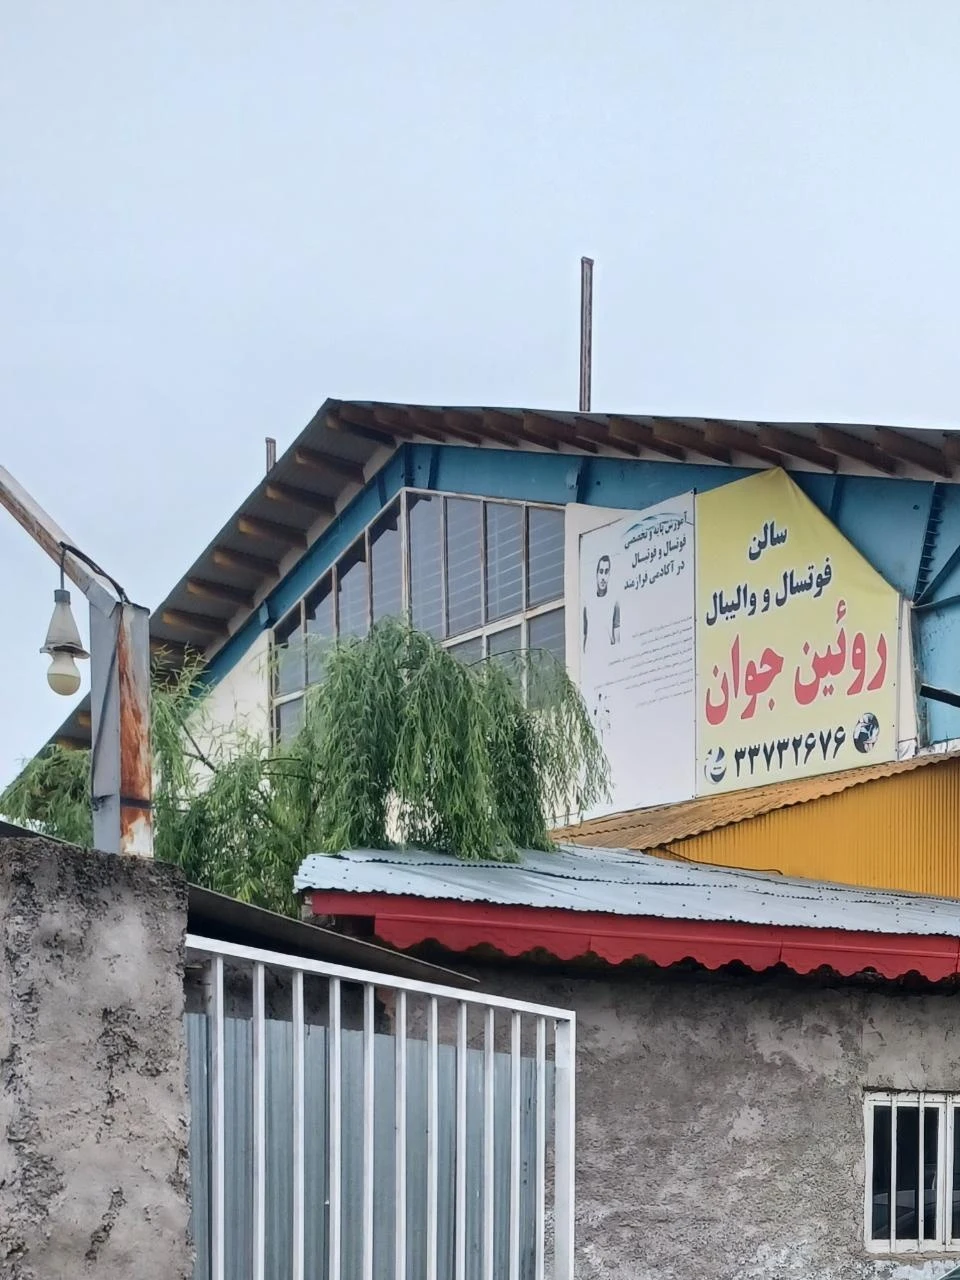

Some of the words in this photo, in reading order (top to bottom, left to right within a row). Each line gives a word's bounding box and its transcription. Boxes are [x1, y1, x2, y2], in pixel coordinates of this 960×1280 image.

[748, 521, 788, 561] سالن
[676, 560, 685, 576] در
[775, 557, 832, 607] فوتسال
[706, 583, 757, 626] والیبال
[761, 588, 770, 613] و
[794, 599, 888, 706] روئین
[705, 633, 785, 726] جوان
[734, 726, 846, 778] ۳۳۷۳۲۶۷۶
